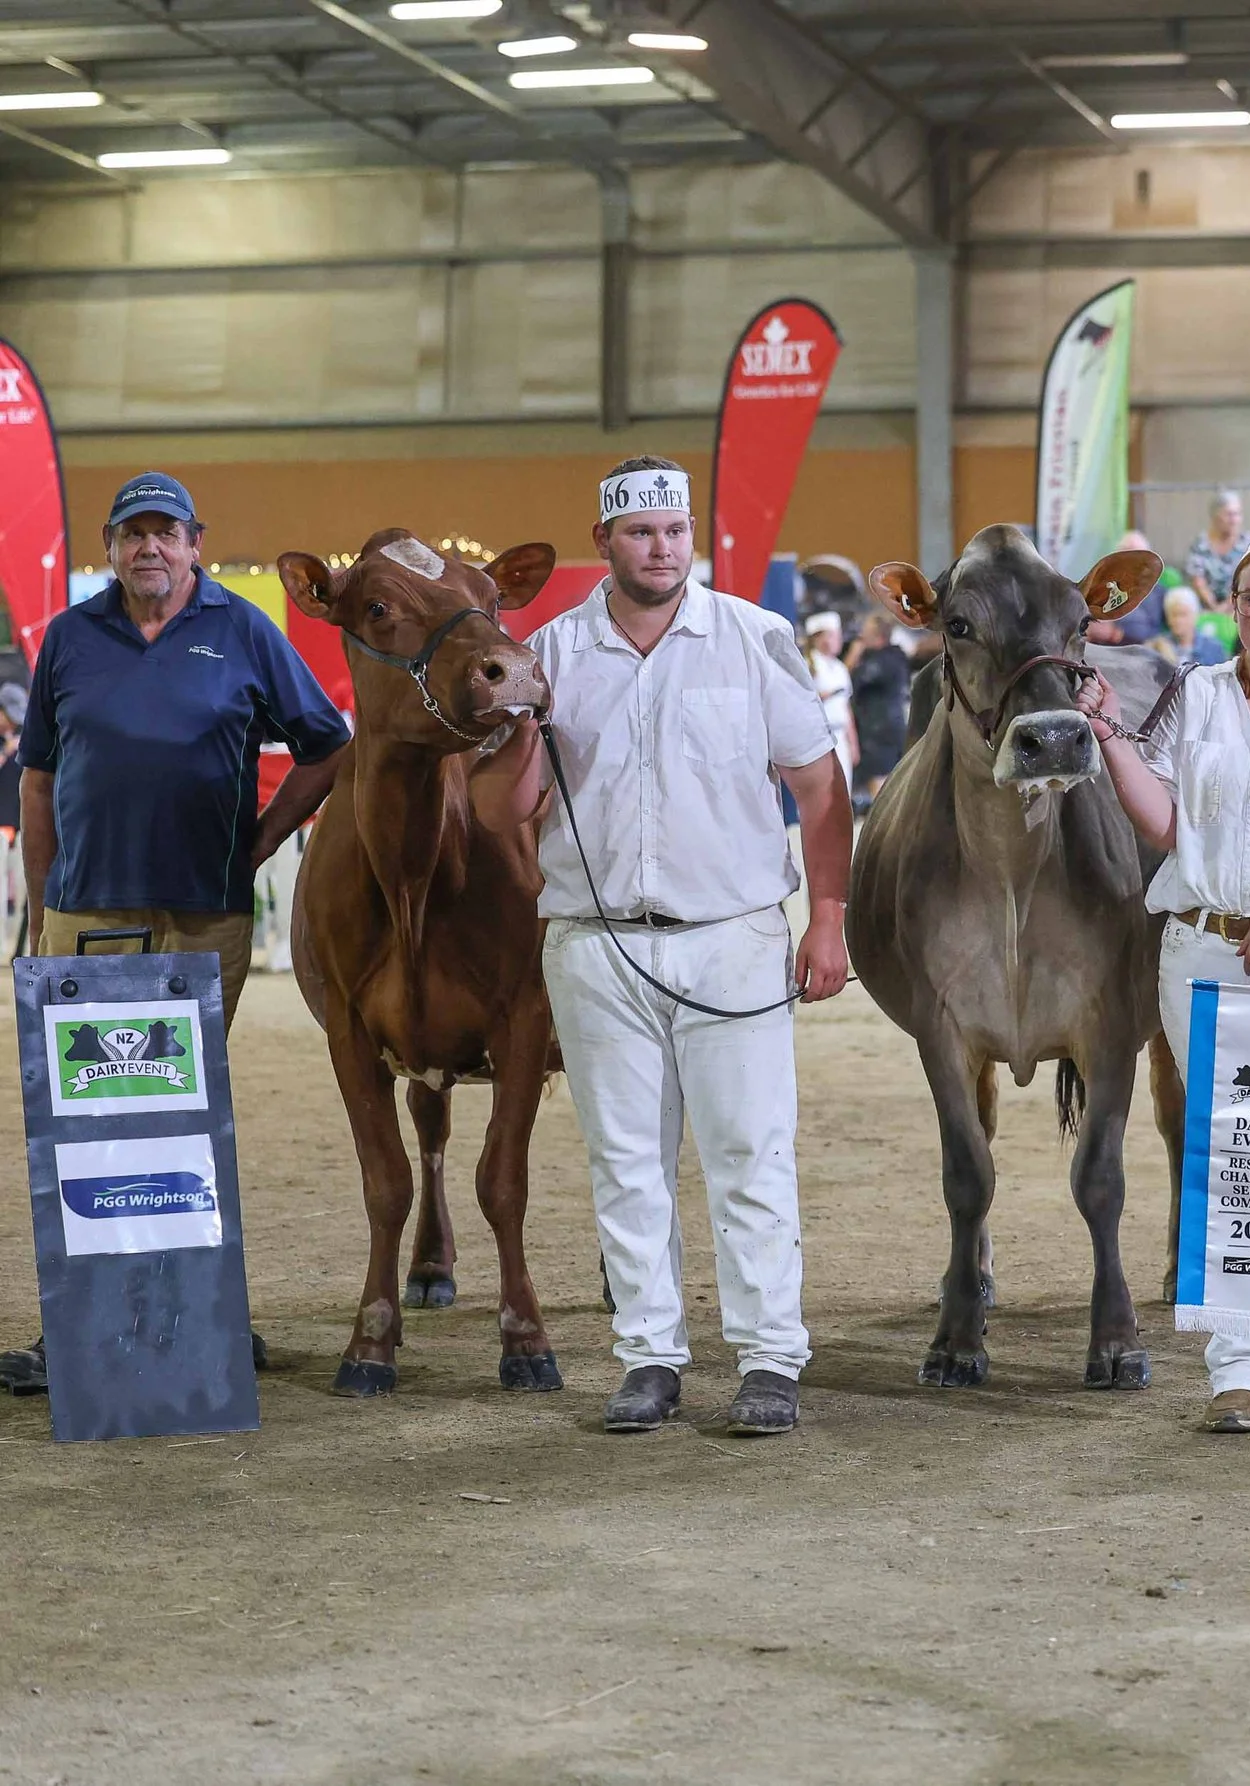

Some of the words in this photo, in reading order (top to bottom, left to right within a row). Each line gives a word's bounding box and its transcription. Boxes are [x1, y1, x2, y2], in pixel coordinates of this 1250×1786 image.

[600, 477, 630, 514] 66
[638, 488, 684, 508] SEMEX
[1110, 594, 1123, 609] 28
[116, 1032, 135, 1045] NZ
[86, 1062, 170, 1080] DAIRYEVENT
[93, 1196, 126, 1209] PGG
[129, 1191, 205, 1208] Wrightson
[1224, 1263, 1243, 1272] PGG
